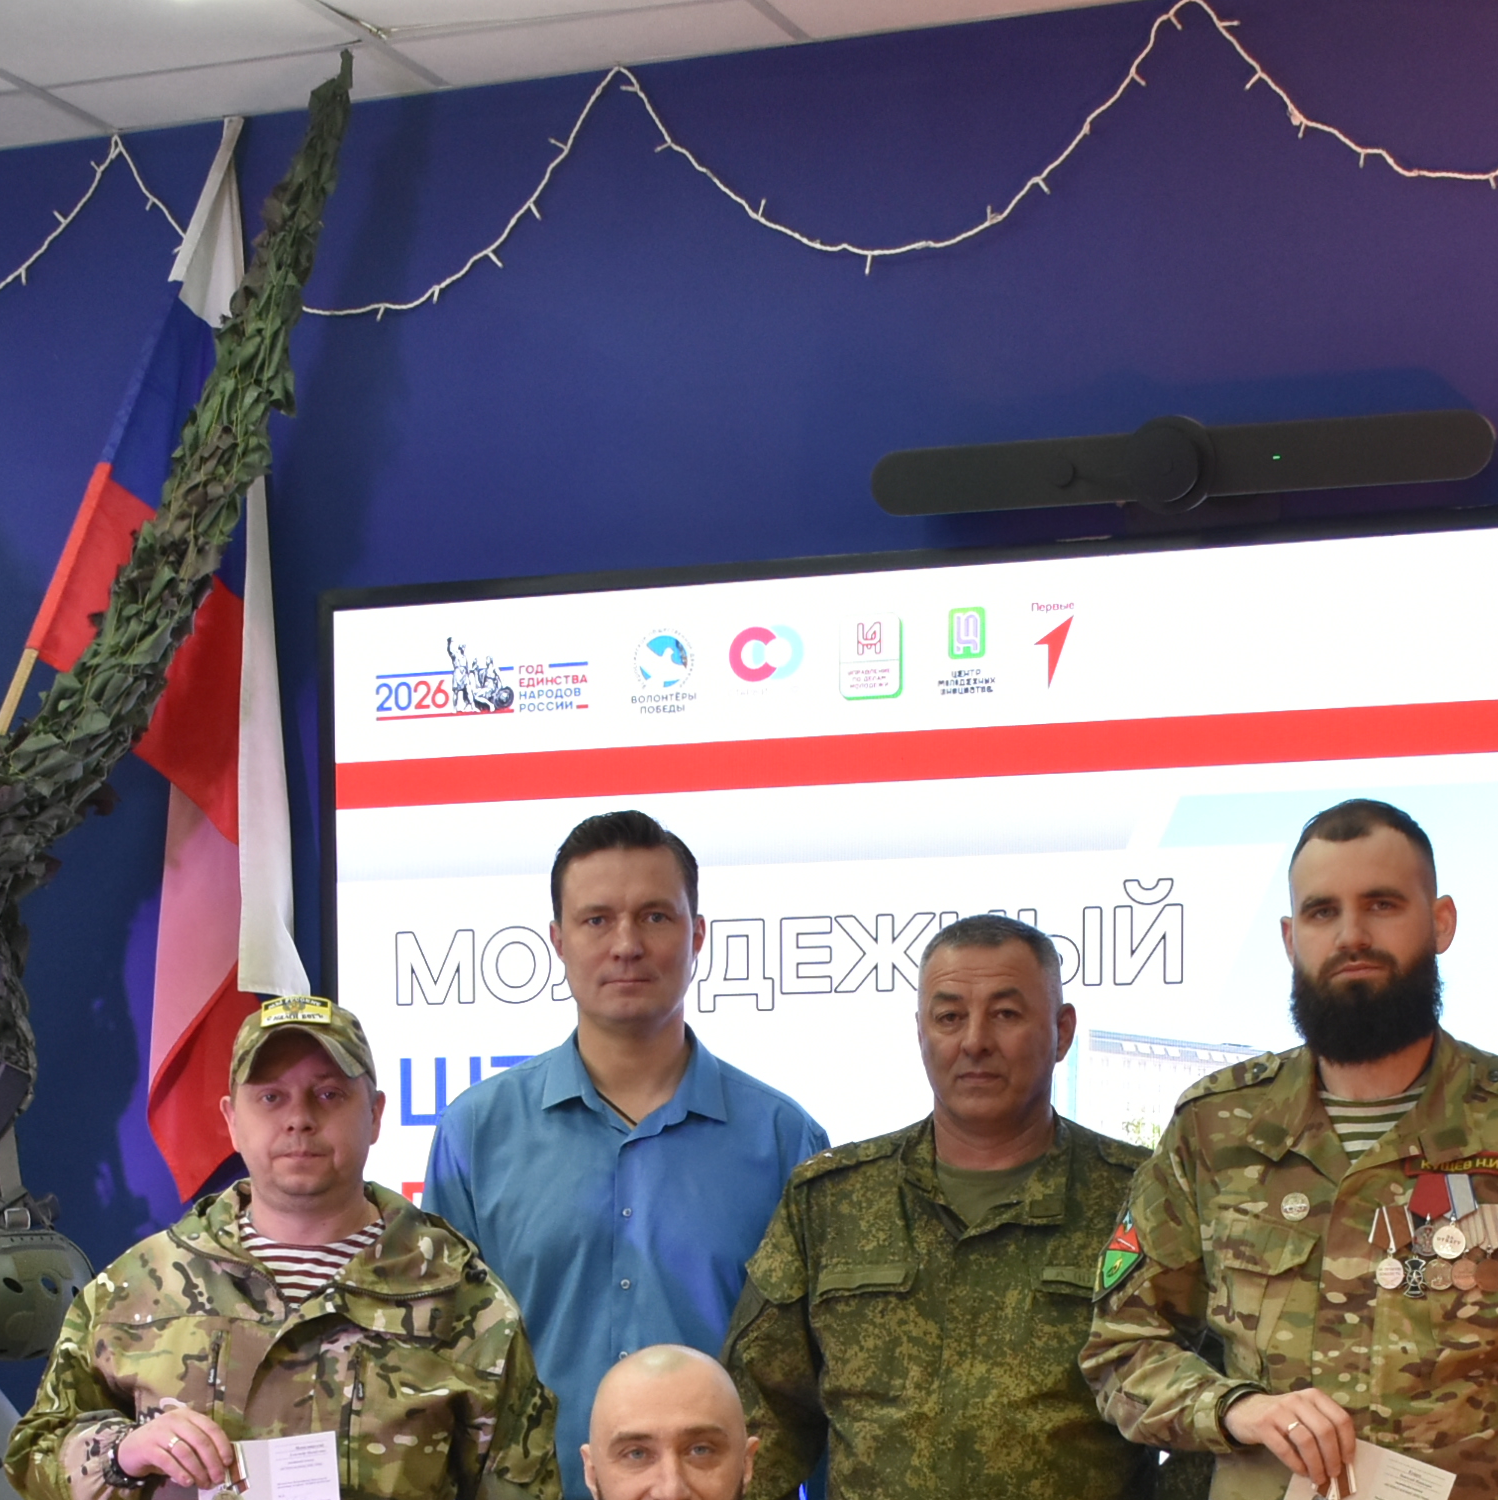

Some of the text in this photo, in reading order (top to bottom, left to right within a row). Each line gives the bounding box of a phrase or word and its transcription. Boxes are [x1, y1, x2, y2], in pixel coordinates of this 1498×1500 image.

[1031, 602, 1075, 613] Первые
[518, 664, 545, 675] ГОД
[518, 675, 588, 688] ЕДИНСТВА
[375, 679, 450, 712] 2026
[518, 688, 581, 700] НАРОДОВ
[518, 700, 574, 712] РОССИИ
[640, 704, 685, 714] ПОБЕДЫ
